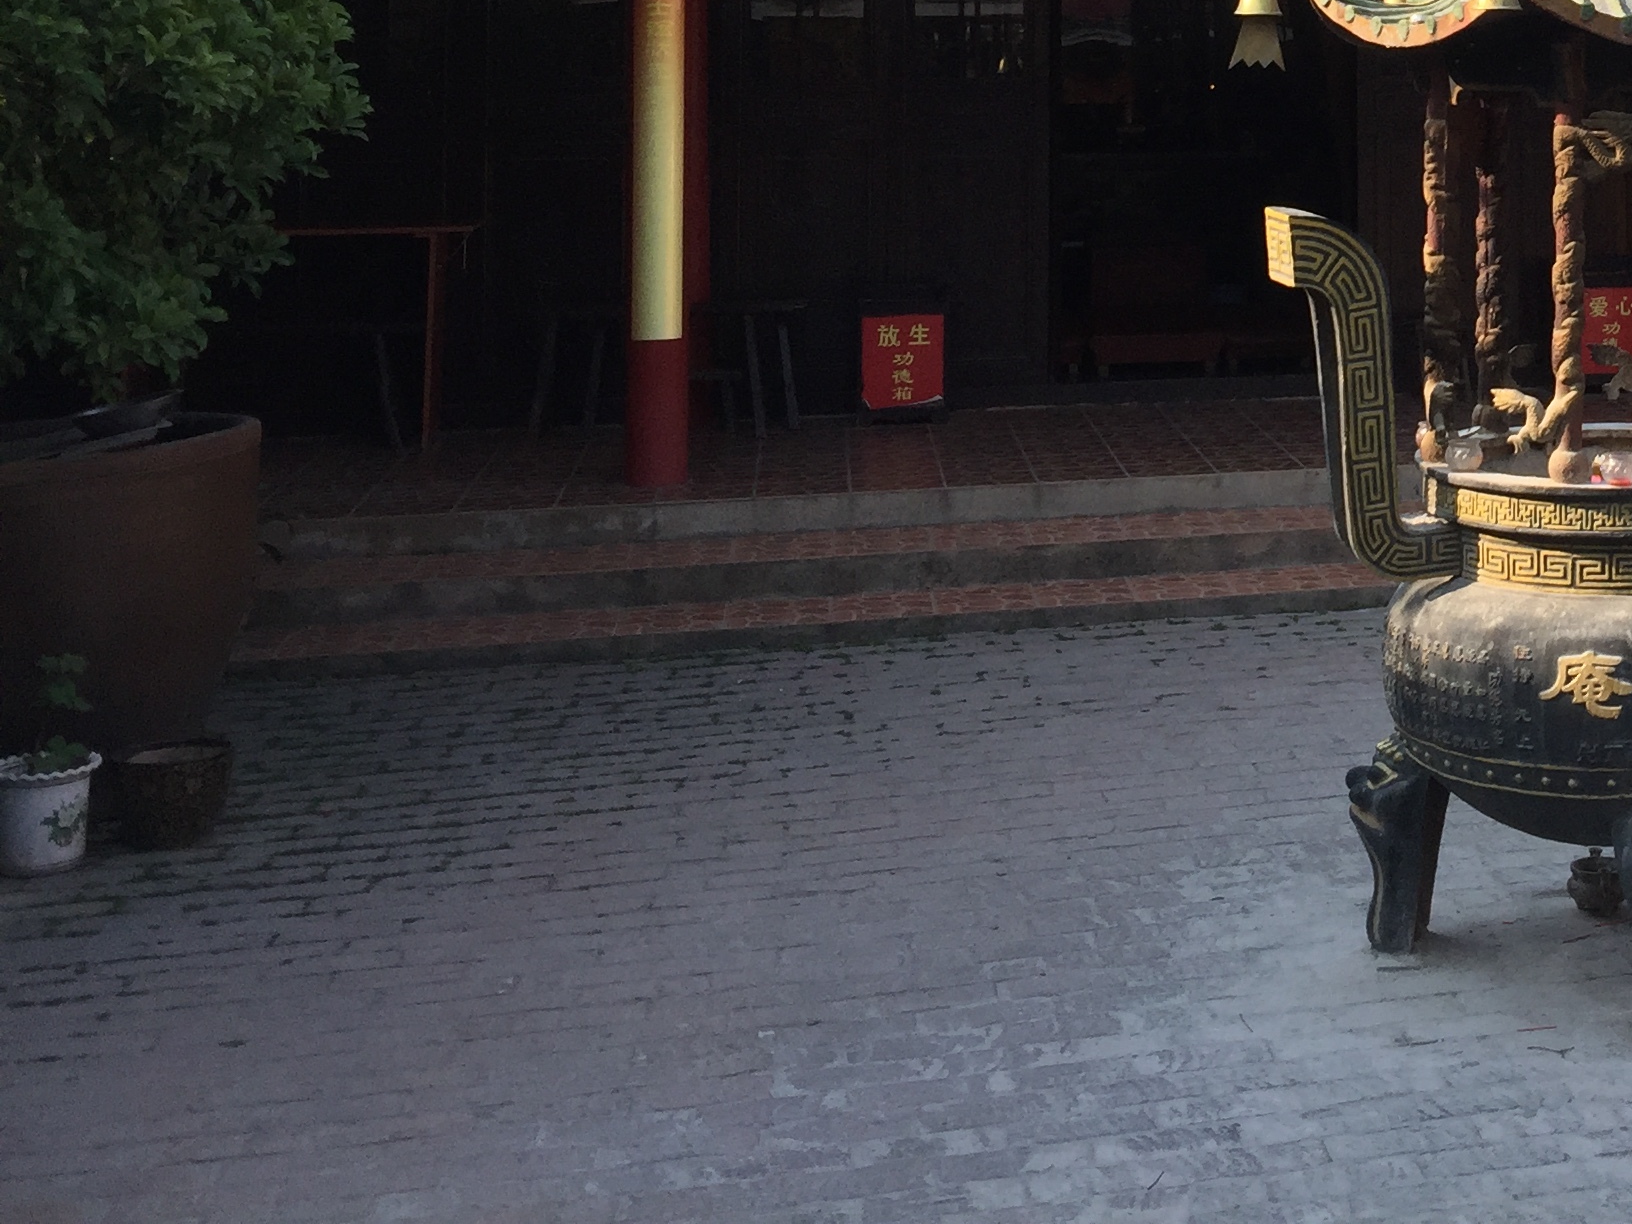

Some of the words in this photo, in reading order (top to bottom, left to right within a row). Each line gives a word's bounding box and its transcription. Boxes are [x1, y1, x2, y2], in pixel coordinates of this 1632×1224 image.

[877, 323, 931, 347] 放生
[891, 351, 915, 401] 功德箱
